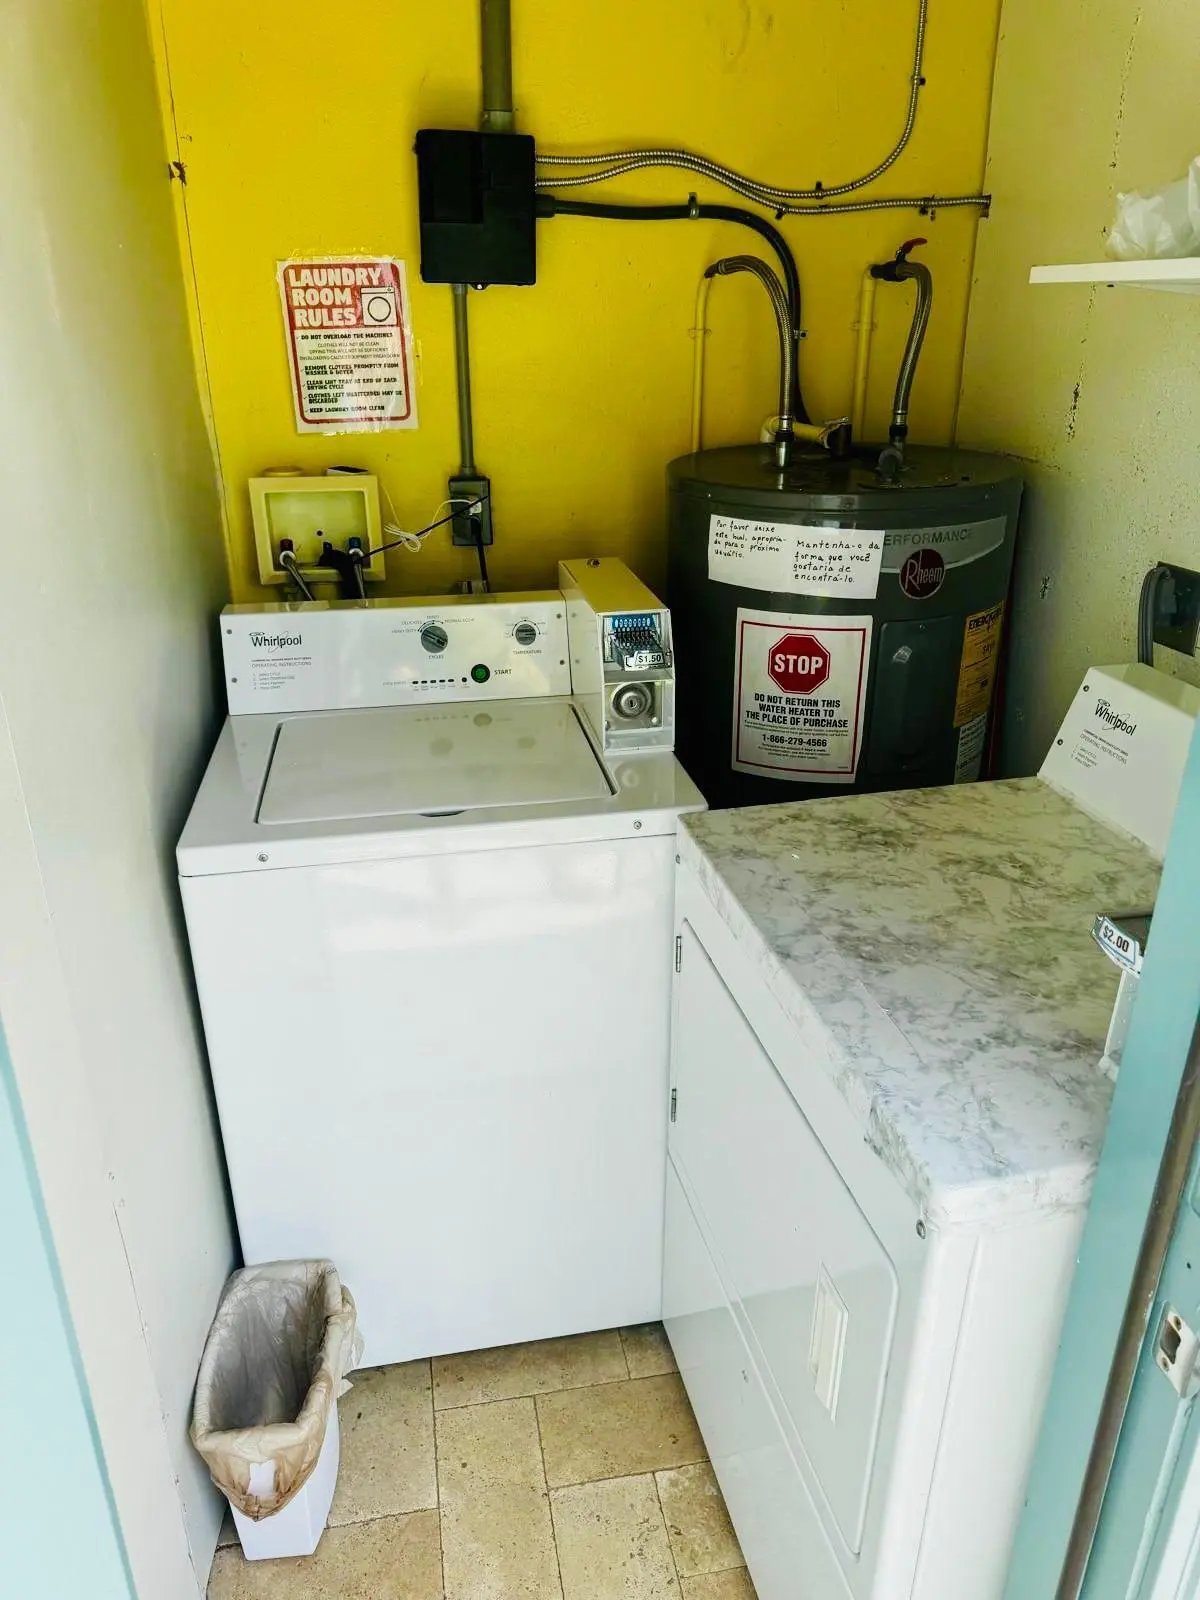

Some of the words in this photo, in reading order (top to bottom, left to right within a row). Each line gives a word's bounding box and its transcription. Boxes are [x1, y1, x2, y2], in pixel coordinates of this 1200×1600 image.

[288, 267, 382, 287] LAUNDRY
[292, 287, 353, 306] ROOM
[294, 307, 357, 327] RULES
[730, 520, 750, 532] favor
[754, 524, 776, 533] deixe
[724, 541, 739, 549] para
[796, 540, 862, 549] Mantenha-o
[868, 541, 881, 550] da
[884, 528, 974, 546] ERFORMANCE
[794, 551, 824, 562] forma
[828, 554, 843, 566] que
[849, 552, 871, 562] você
[792, 561, 834, 572] gostaria
[838, 565, 851, 573] de
[905, 551, 943, 591] Rheem
[251, 633, 302, 649] Whirlpool
[638, 654, 661, 663] $1.50
[774, 653, 823, 675] STOP
[754, 693, 765, 702] DO
[767, 695, 783, 704] NOT
[785, 697, 819, 707] RETURN
[821, 699, 841, 708] THIS
[759, 703, 786, 715] WATER
[788, 707, 821, 717] HEATER
[823, 709, 834, 718] TO
[745, 710, 760, 720] THE
[762, 713, 788, 725] PLACE
[790, 716, 801, 726] OF
[803, 718, 849, 728] PURCHASE
[1094, 703, 1137, 736] Whirlpool
[762, 733, 828, 747] 1-866-279-4566
[1102, 924, 1130, 953] $2.00
